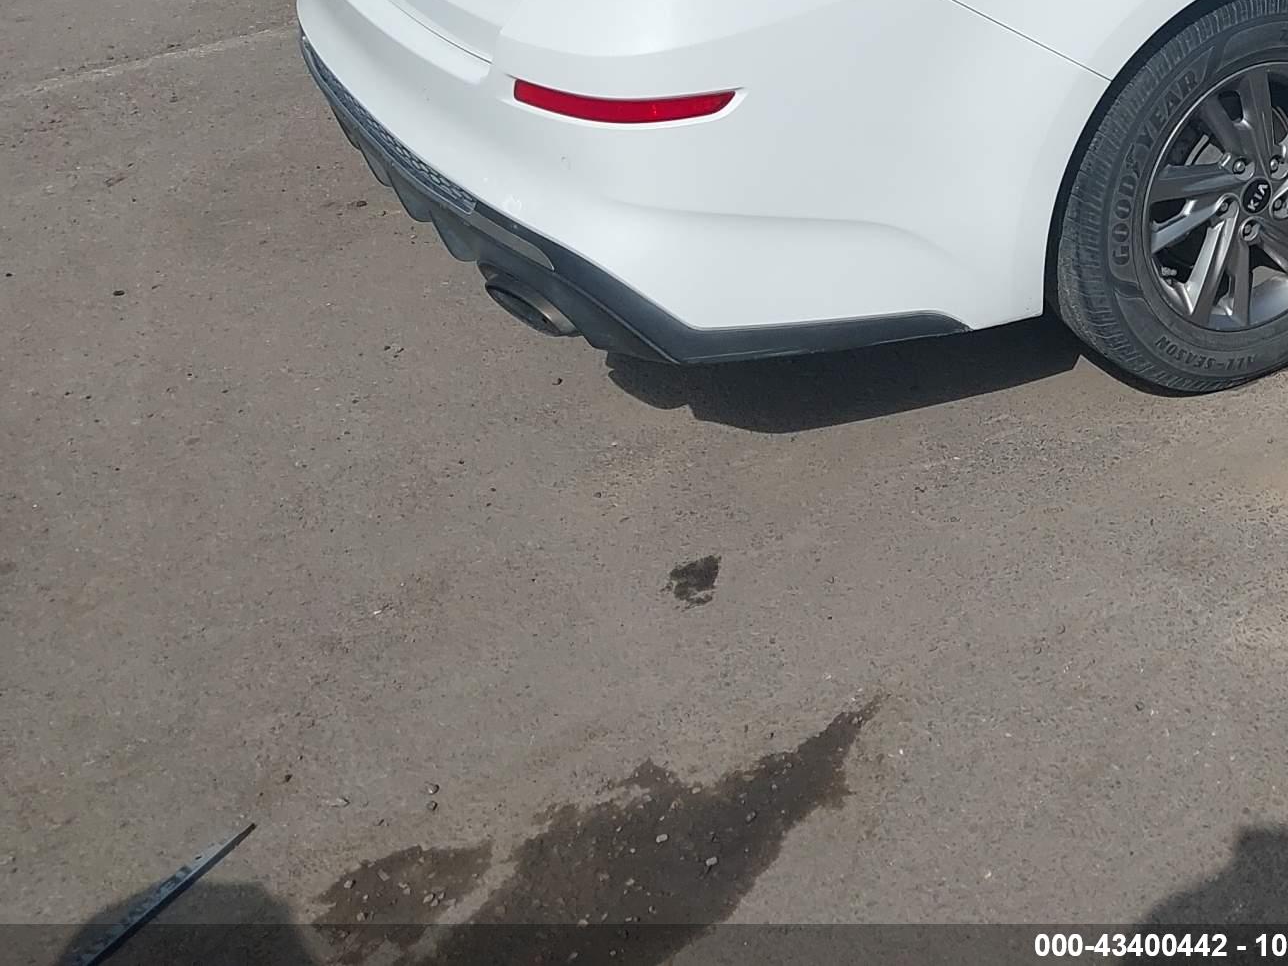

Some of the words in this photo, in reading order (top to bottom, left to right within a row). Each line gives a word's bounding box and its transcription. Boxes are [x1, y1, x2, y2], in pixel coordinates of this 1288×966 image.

[1111, 69, 1199, 266] GOODYEAR
[1247, 184, 1269, 211] KIA
[1154, 335, 1257, 371] ALL-SEASON
